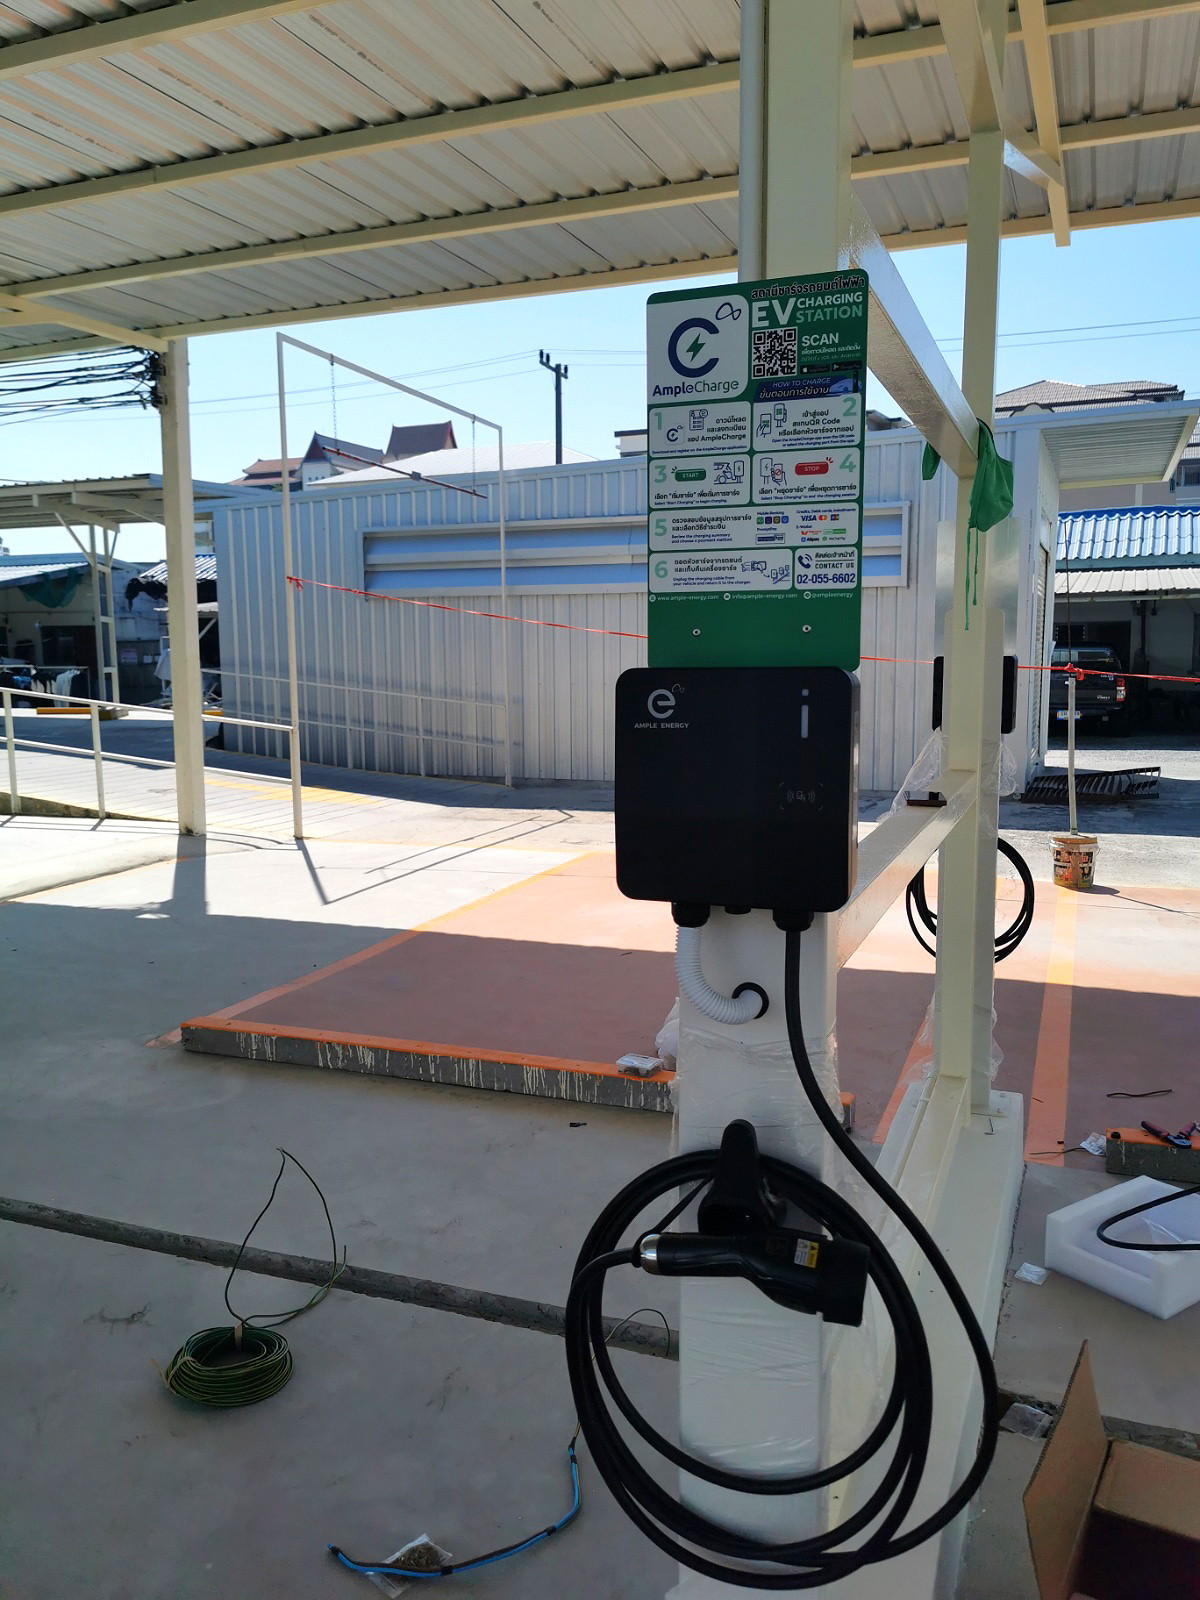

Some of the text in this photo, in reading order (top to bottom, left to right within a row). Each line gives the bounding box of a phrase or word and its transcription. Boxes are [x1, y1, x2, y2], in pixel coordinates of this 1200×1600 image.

[751, 274, 866, 299] สถานีชาร์จรถยนต์ไฟฟ้า
[797, 292, 863, 309] CHARGING
[752, 297, 797, 328] EV
[796, 304, 863, 324] STATION
[802, 332, 839, 347] SCAN
[652, 380, 739, 397] AmpleCharge
[802, 377, 831, 386] CHARGE
[759, 386, 829, 399] ขั้นตอนการใช้งาน
[843, 397, 857, 417] 2
[654, 411, 662, 430] 1
[822, 417, 840, 425] Code
[700, 433, 746, 442] AmpleCharge
[839, 453, 856, 473] 4
[654, 465, 667, 483] 3
[654, 518, 667, 536] 5
[654, 560, 668, 578] 6
[815, 562, 843, 570] CONTACT
[796, 573, 856, 584] 02-055-6602
